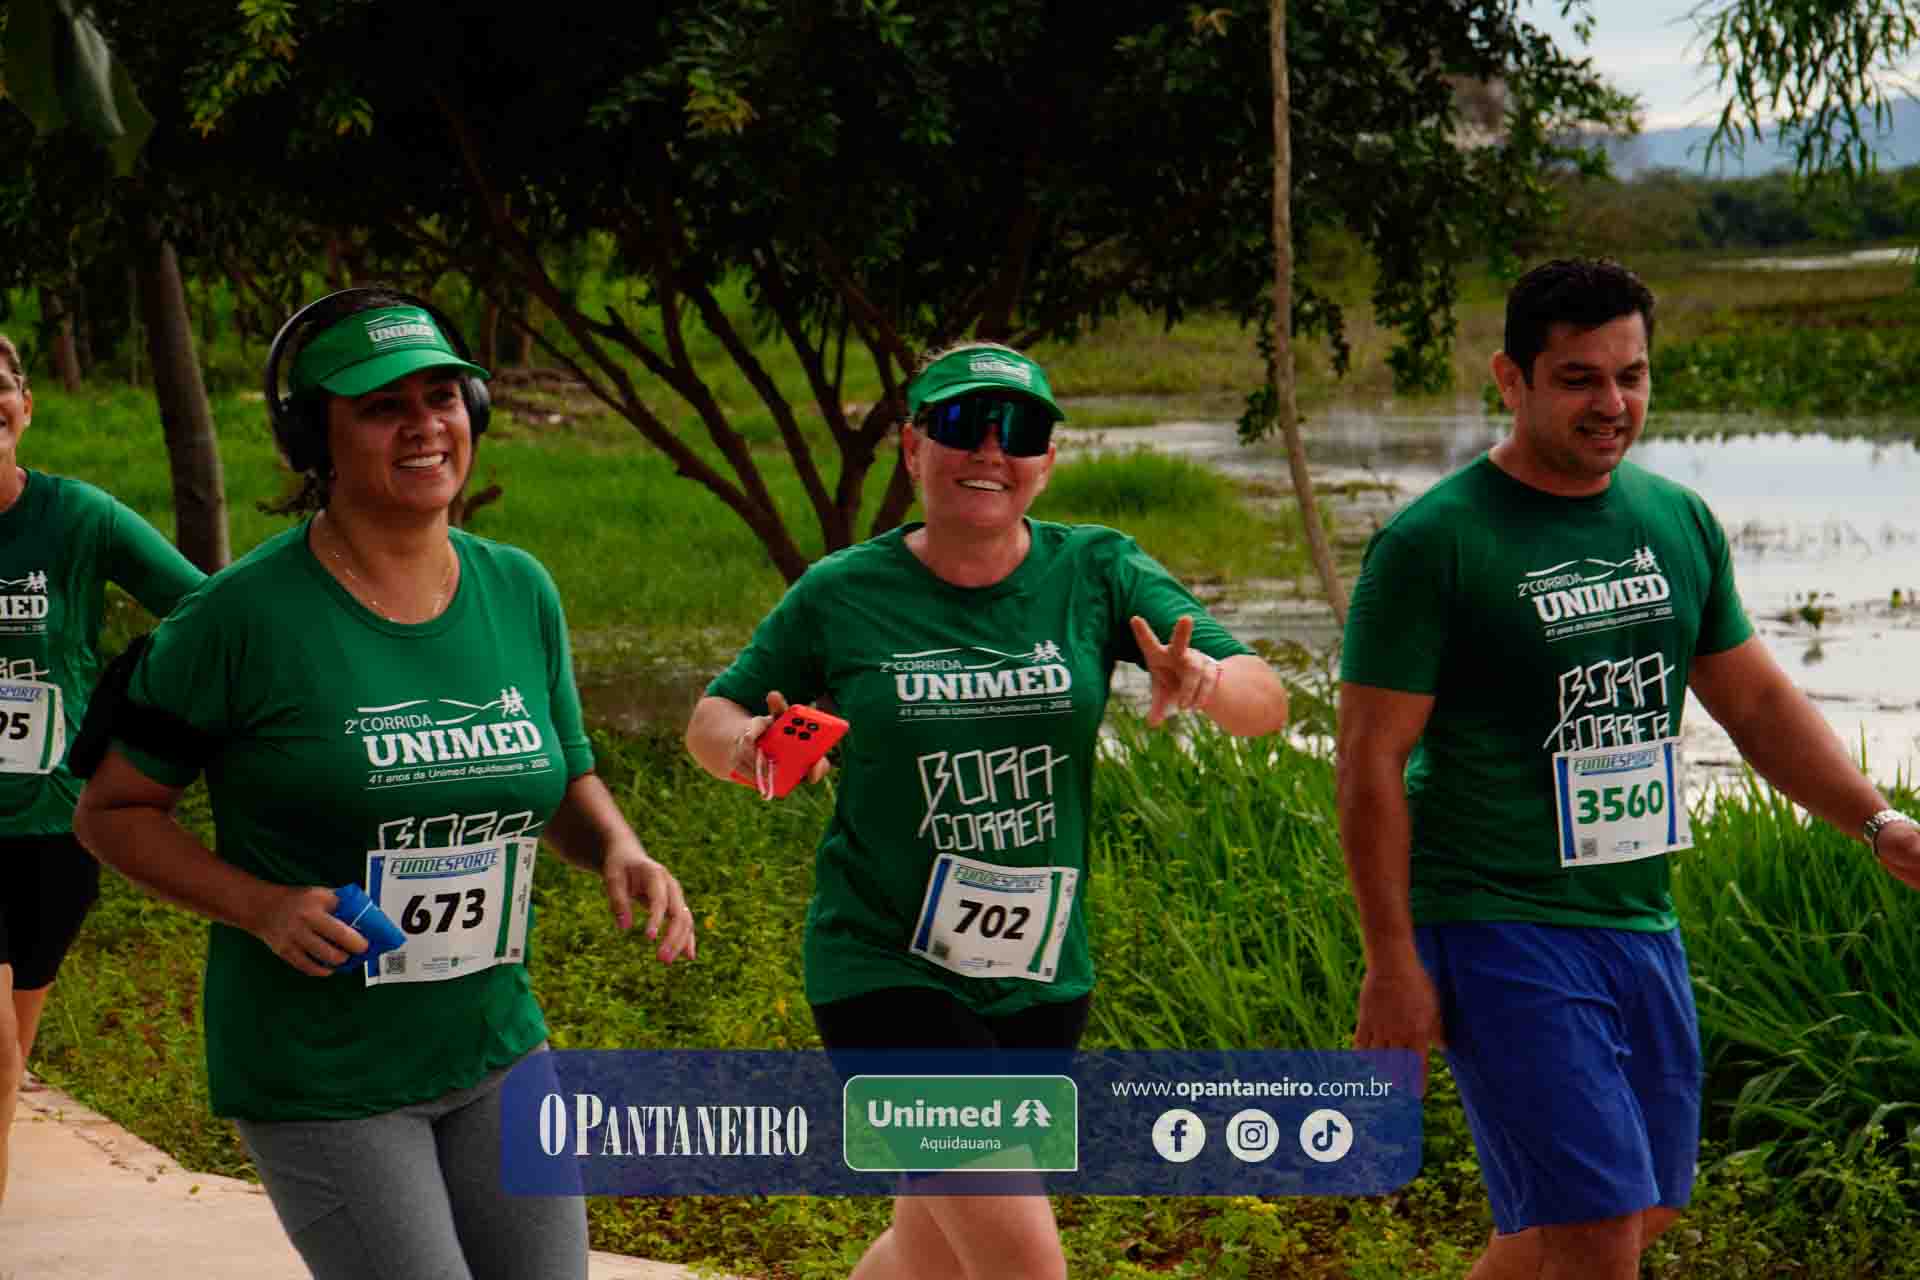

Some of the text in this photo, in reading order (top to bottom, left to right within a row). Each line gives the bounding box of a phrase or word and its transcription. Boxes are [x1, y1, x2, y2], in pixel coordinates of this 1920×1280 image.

[1532, 573, 1670, 622] UNIMED
[895, 660, 962, 671] CORRIDA
[895, 664, 1072, 701] UNIMED
[360, 714, 433, 732] CORRIDA
[363, 720, 542, 768] UNIMED
[917, 745, 1070, 838] BORA
[1576, 780, 1664, 825] 3560
[401, 888, 486, 935] 673
[953, 899, 1031, 940] 702
